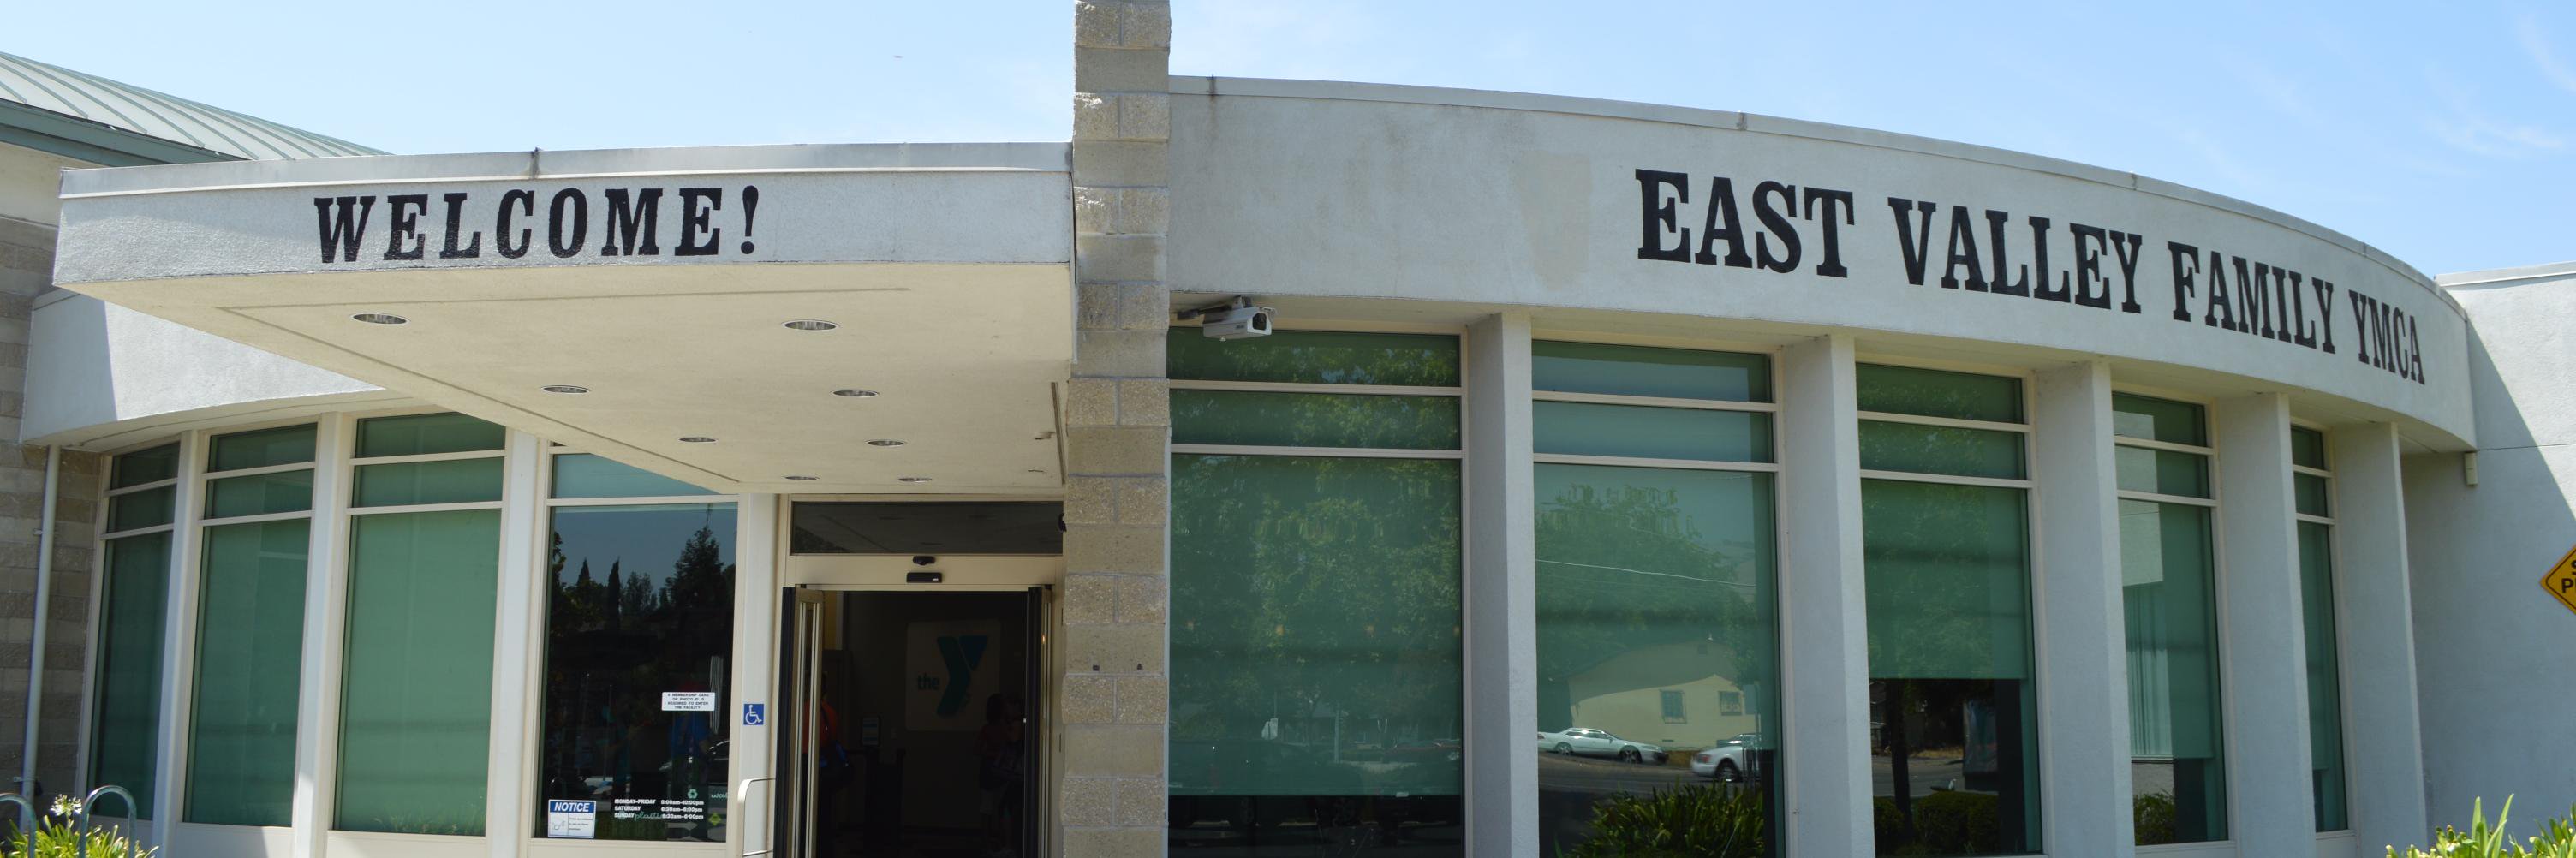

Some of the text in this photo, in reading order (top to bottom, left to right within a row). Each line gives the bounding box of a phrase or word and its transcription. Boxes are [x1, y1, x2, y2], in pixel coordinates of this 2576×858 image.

[313, 185, 760, 263] WELCOME!
[1635, 169, 2425, 385] EAST VALLEY FAMILY YMCA
[917, 672, 939, 690] the
[554, 802, 591, 813] NOTICE
